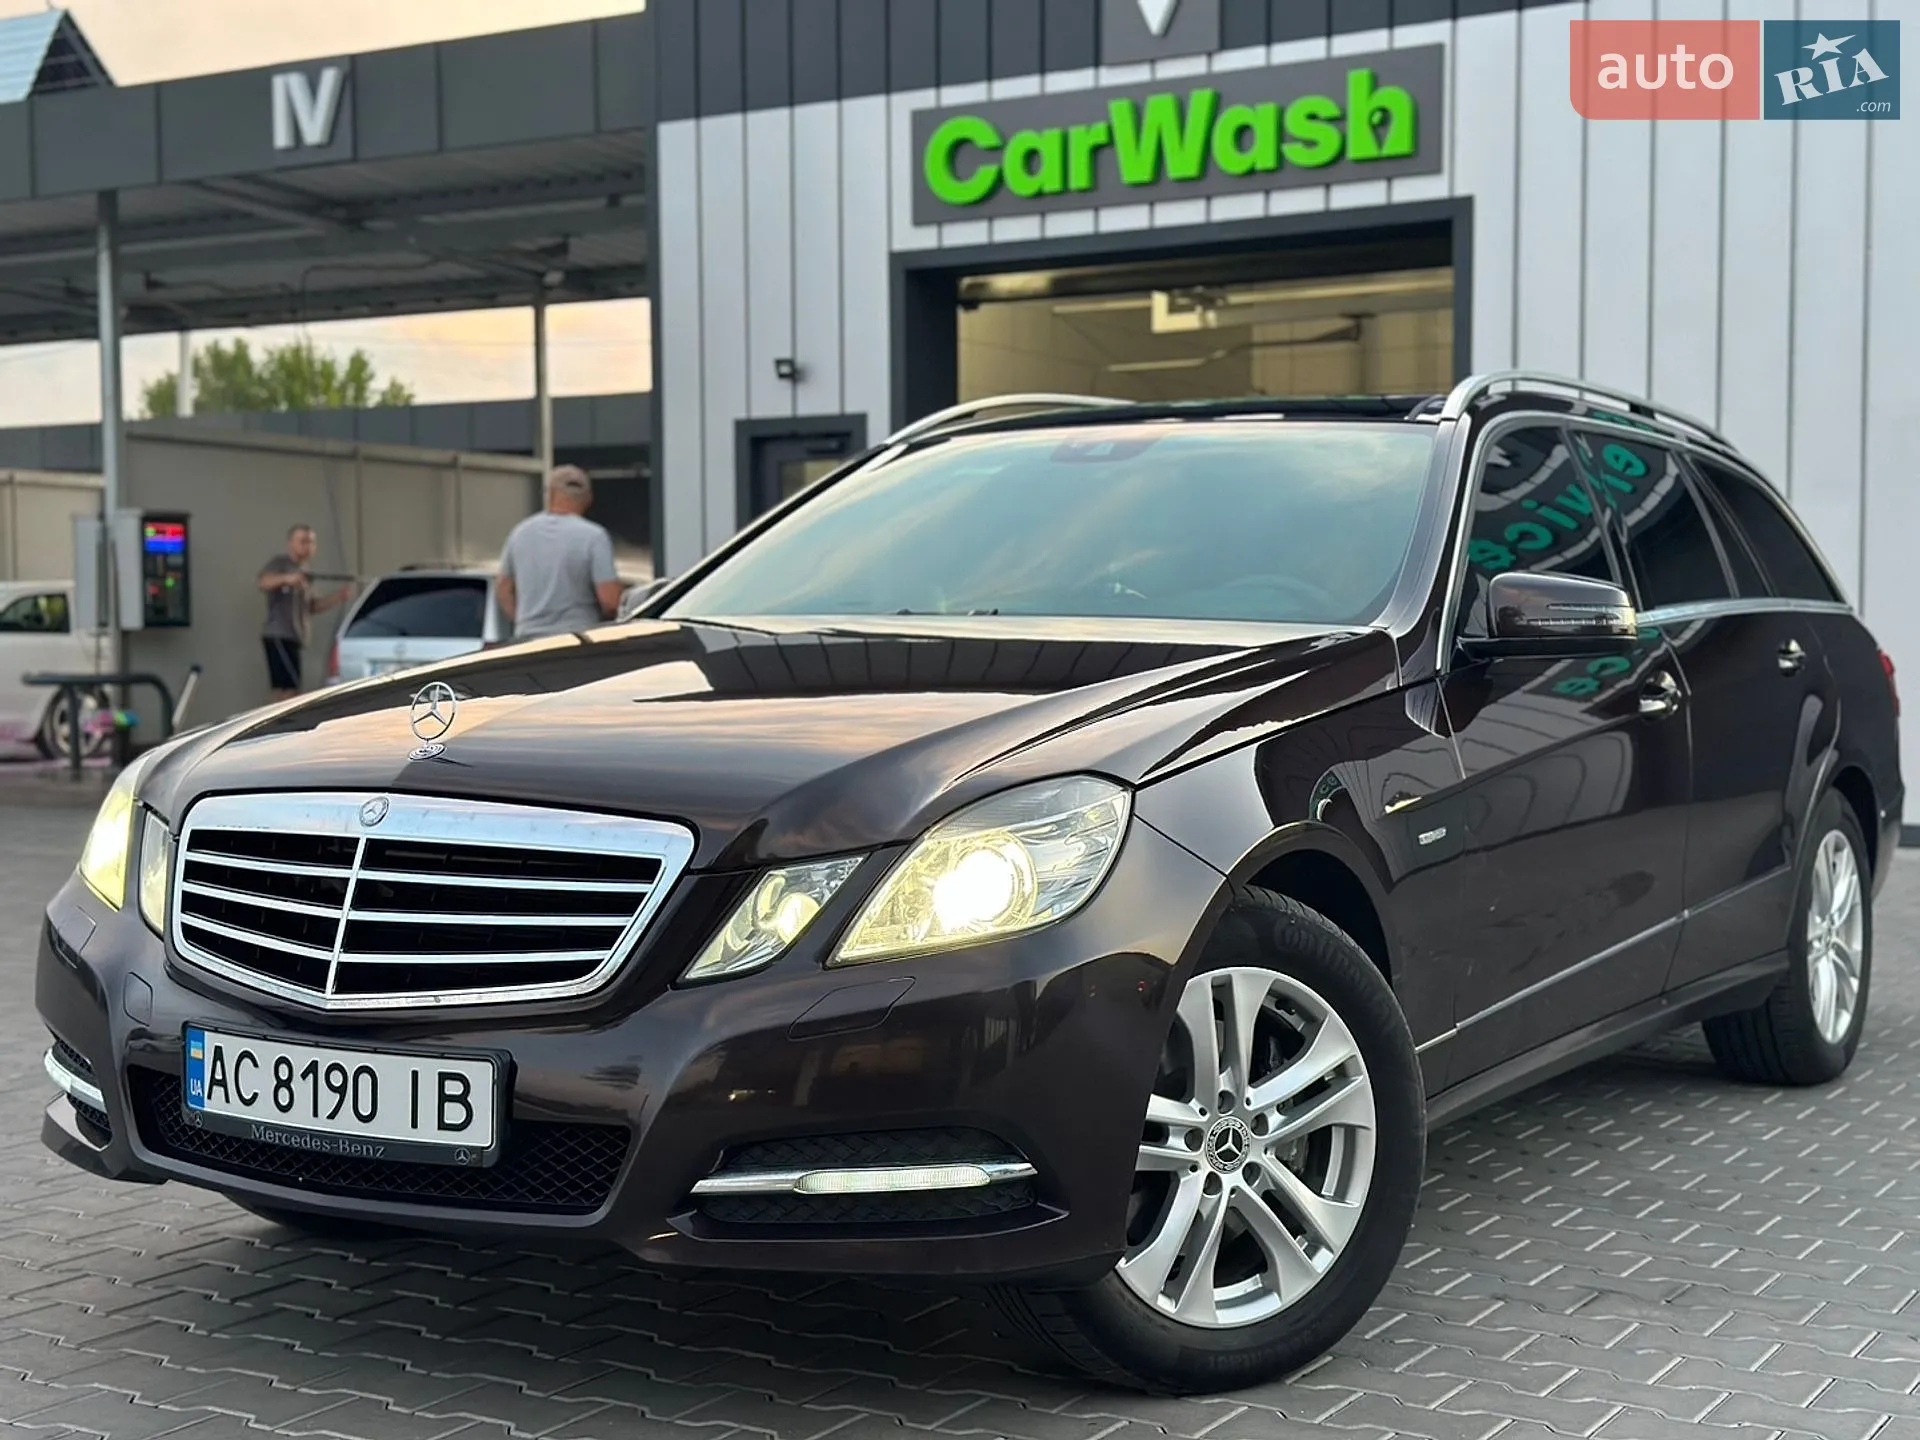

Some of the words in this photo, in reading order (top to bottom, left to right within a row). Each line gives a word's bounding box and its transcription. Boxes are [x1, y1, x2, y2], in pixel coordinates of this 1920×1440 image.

[924, 68, 1417, 206] CarWash
[190, 1077, 203, 1097] UA
[206, 1044, 260, 1107] AC
[272, 1055, 378, 1124] 8190
[410, 1069, 474, 1132] IB
[250, 1123, 385, 1159] Mercedes-Benz
